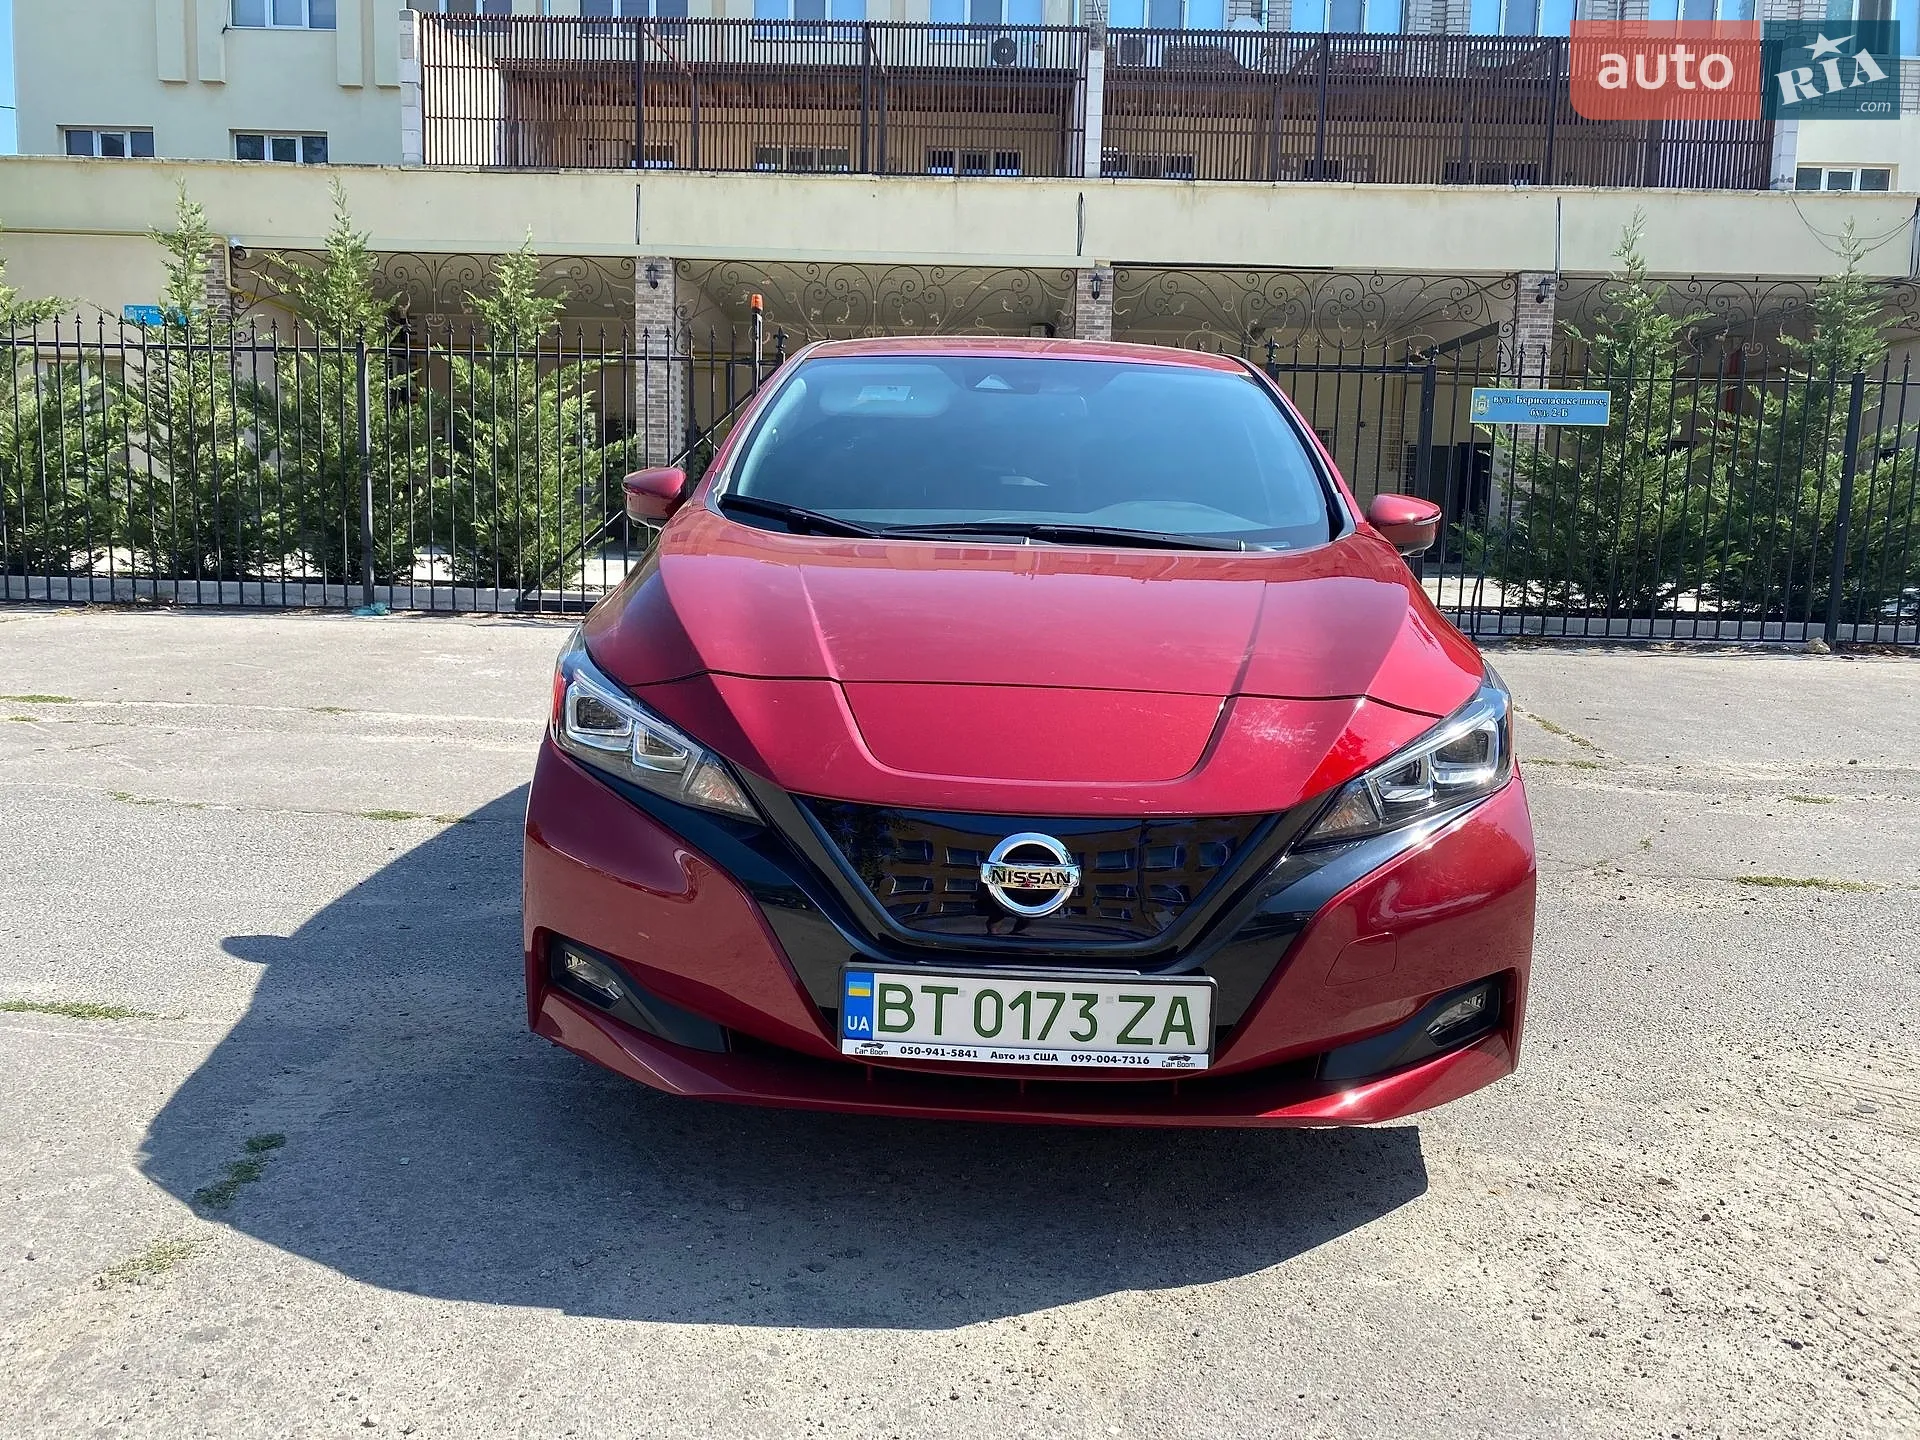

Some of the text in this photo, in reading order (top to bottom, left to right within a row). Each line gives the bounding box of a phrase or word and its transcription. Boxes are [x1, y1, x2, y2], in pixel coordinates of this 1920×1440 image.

[1493, 396, 1513, 406] вул.
[991, 870, 1071, 884] NISSAN
[877, 982, 1196, 1046] BT 0173 ZA
[847, 1015, 870, 1031] UA
[854, 1047, 889, 1056] Car Boom
[900, 1046, 978, 1058] 050-941-5841
[990, 1051, 1058, 1062] Авто из США
[1071, 1054, 1150, 1065] 099-004-7316
[1161, 1060, 1196, 1068] Car Boom
